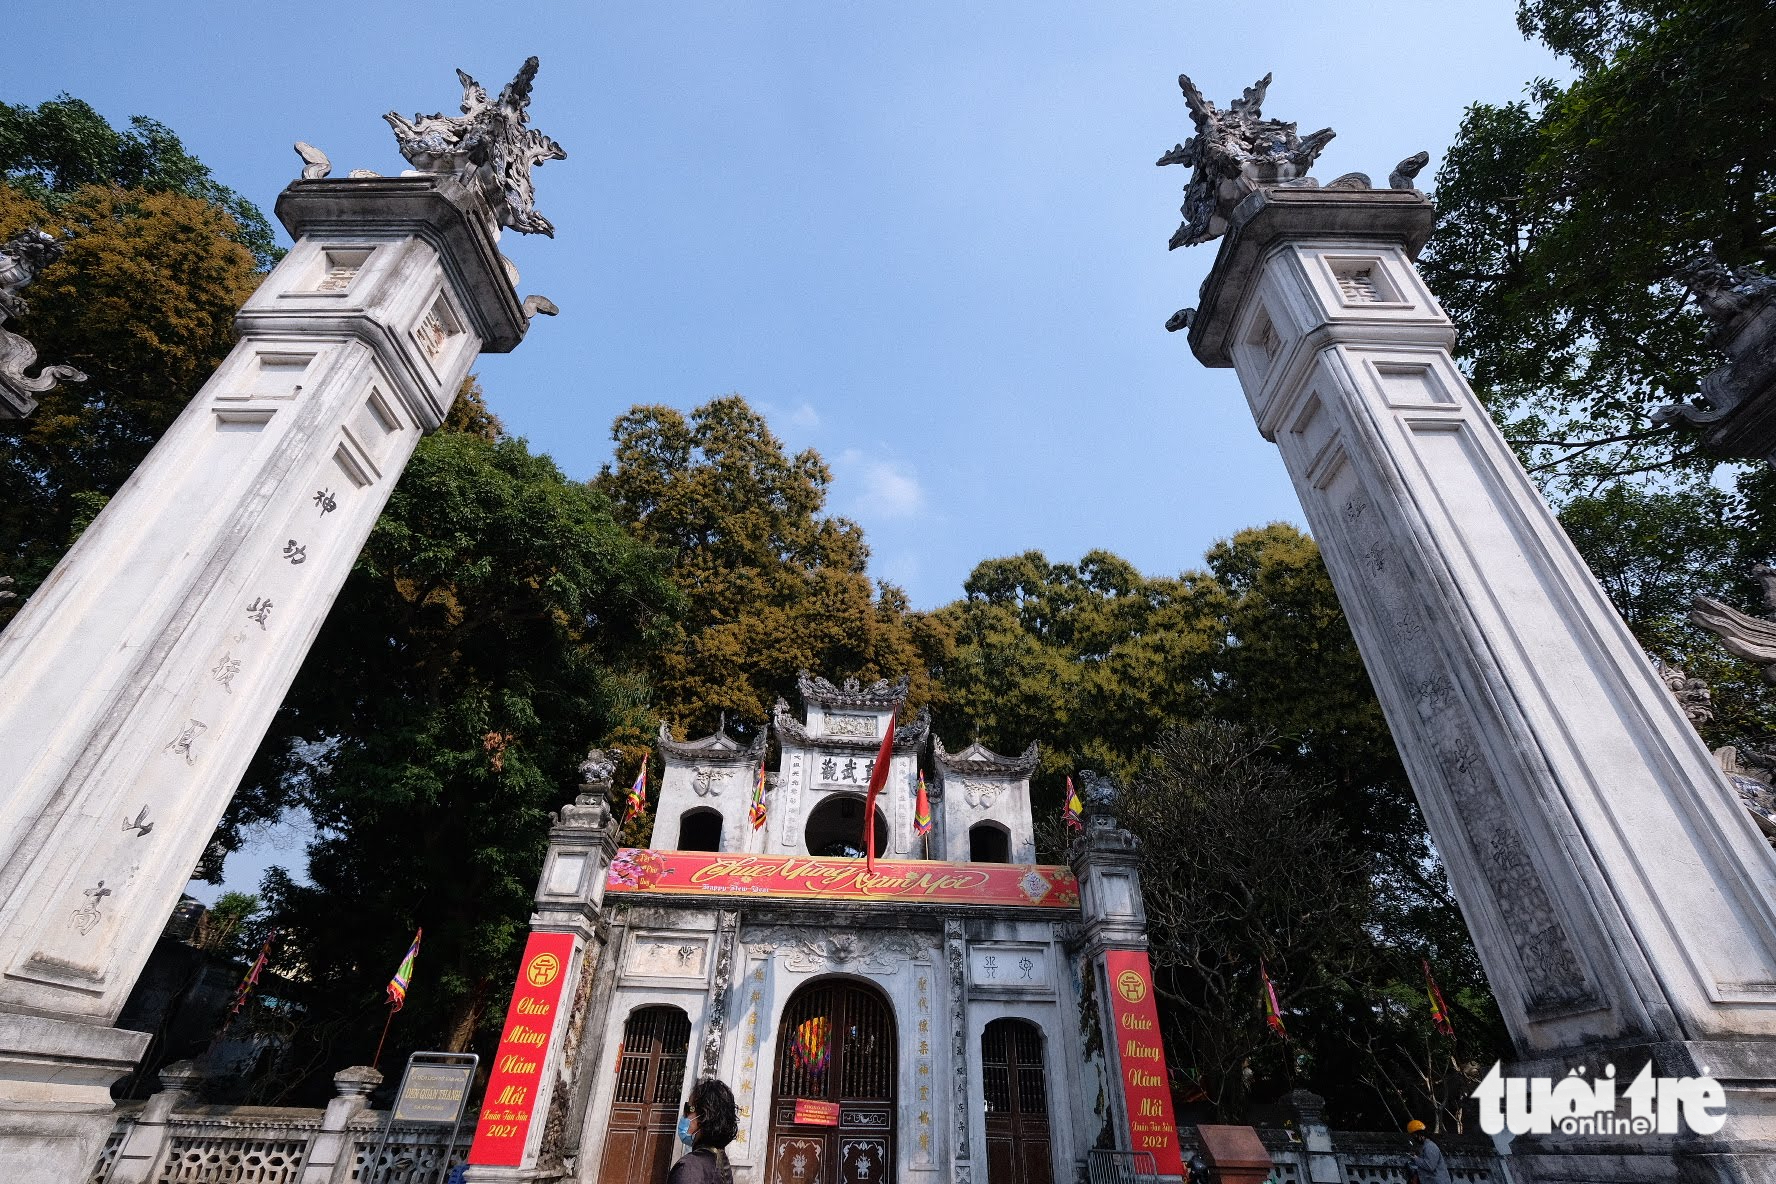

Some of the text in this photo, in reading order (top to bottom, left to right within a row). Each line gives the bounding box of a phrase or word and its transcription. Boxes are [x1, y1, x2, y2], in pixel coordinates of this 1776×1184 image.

[702, 883, 727, 892] Happy
[730, 884, 748, 892] New
[517, 996, 550, 1015] Chúc
[1122, 1012, 1152, 1030] Chúc
[503, 1025, 547, 1049] Mừng
[1123, 1040, 1160, 1063] Mừng
[500, 1054, 536, 1074] Năm
[1128, 1068, 1163, 1087] Năm
[494, 1085, 528, 1105] Mới
[1137, 1098, 1164, 1116] Mới
[486, 1124, 518, 1138] 2021
[1142, 1135, 1169, 1148] 2021
